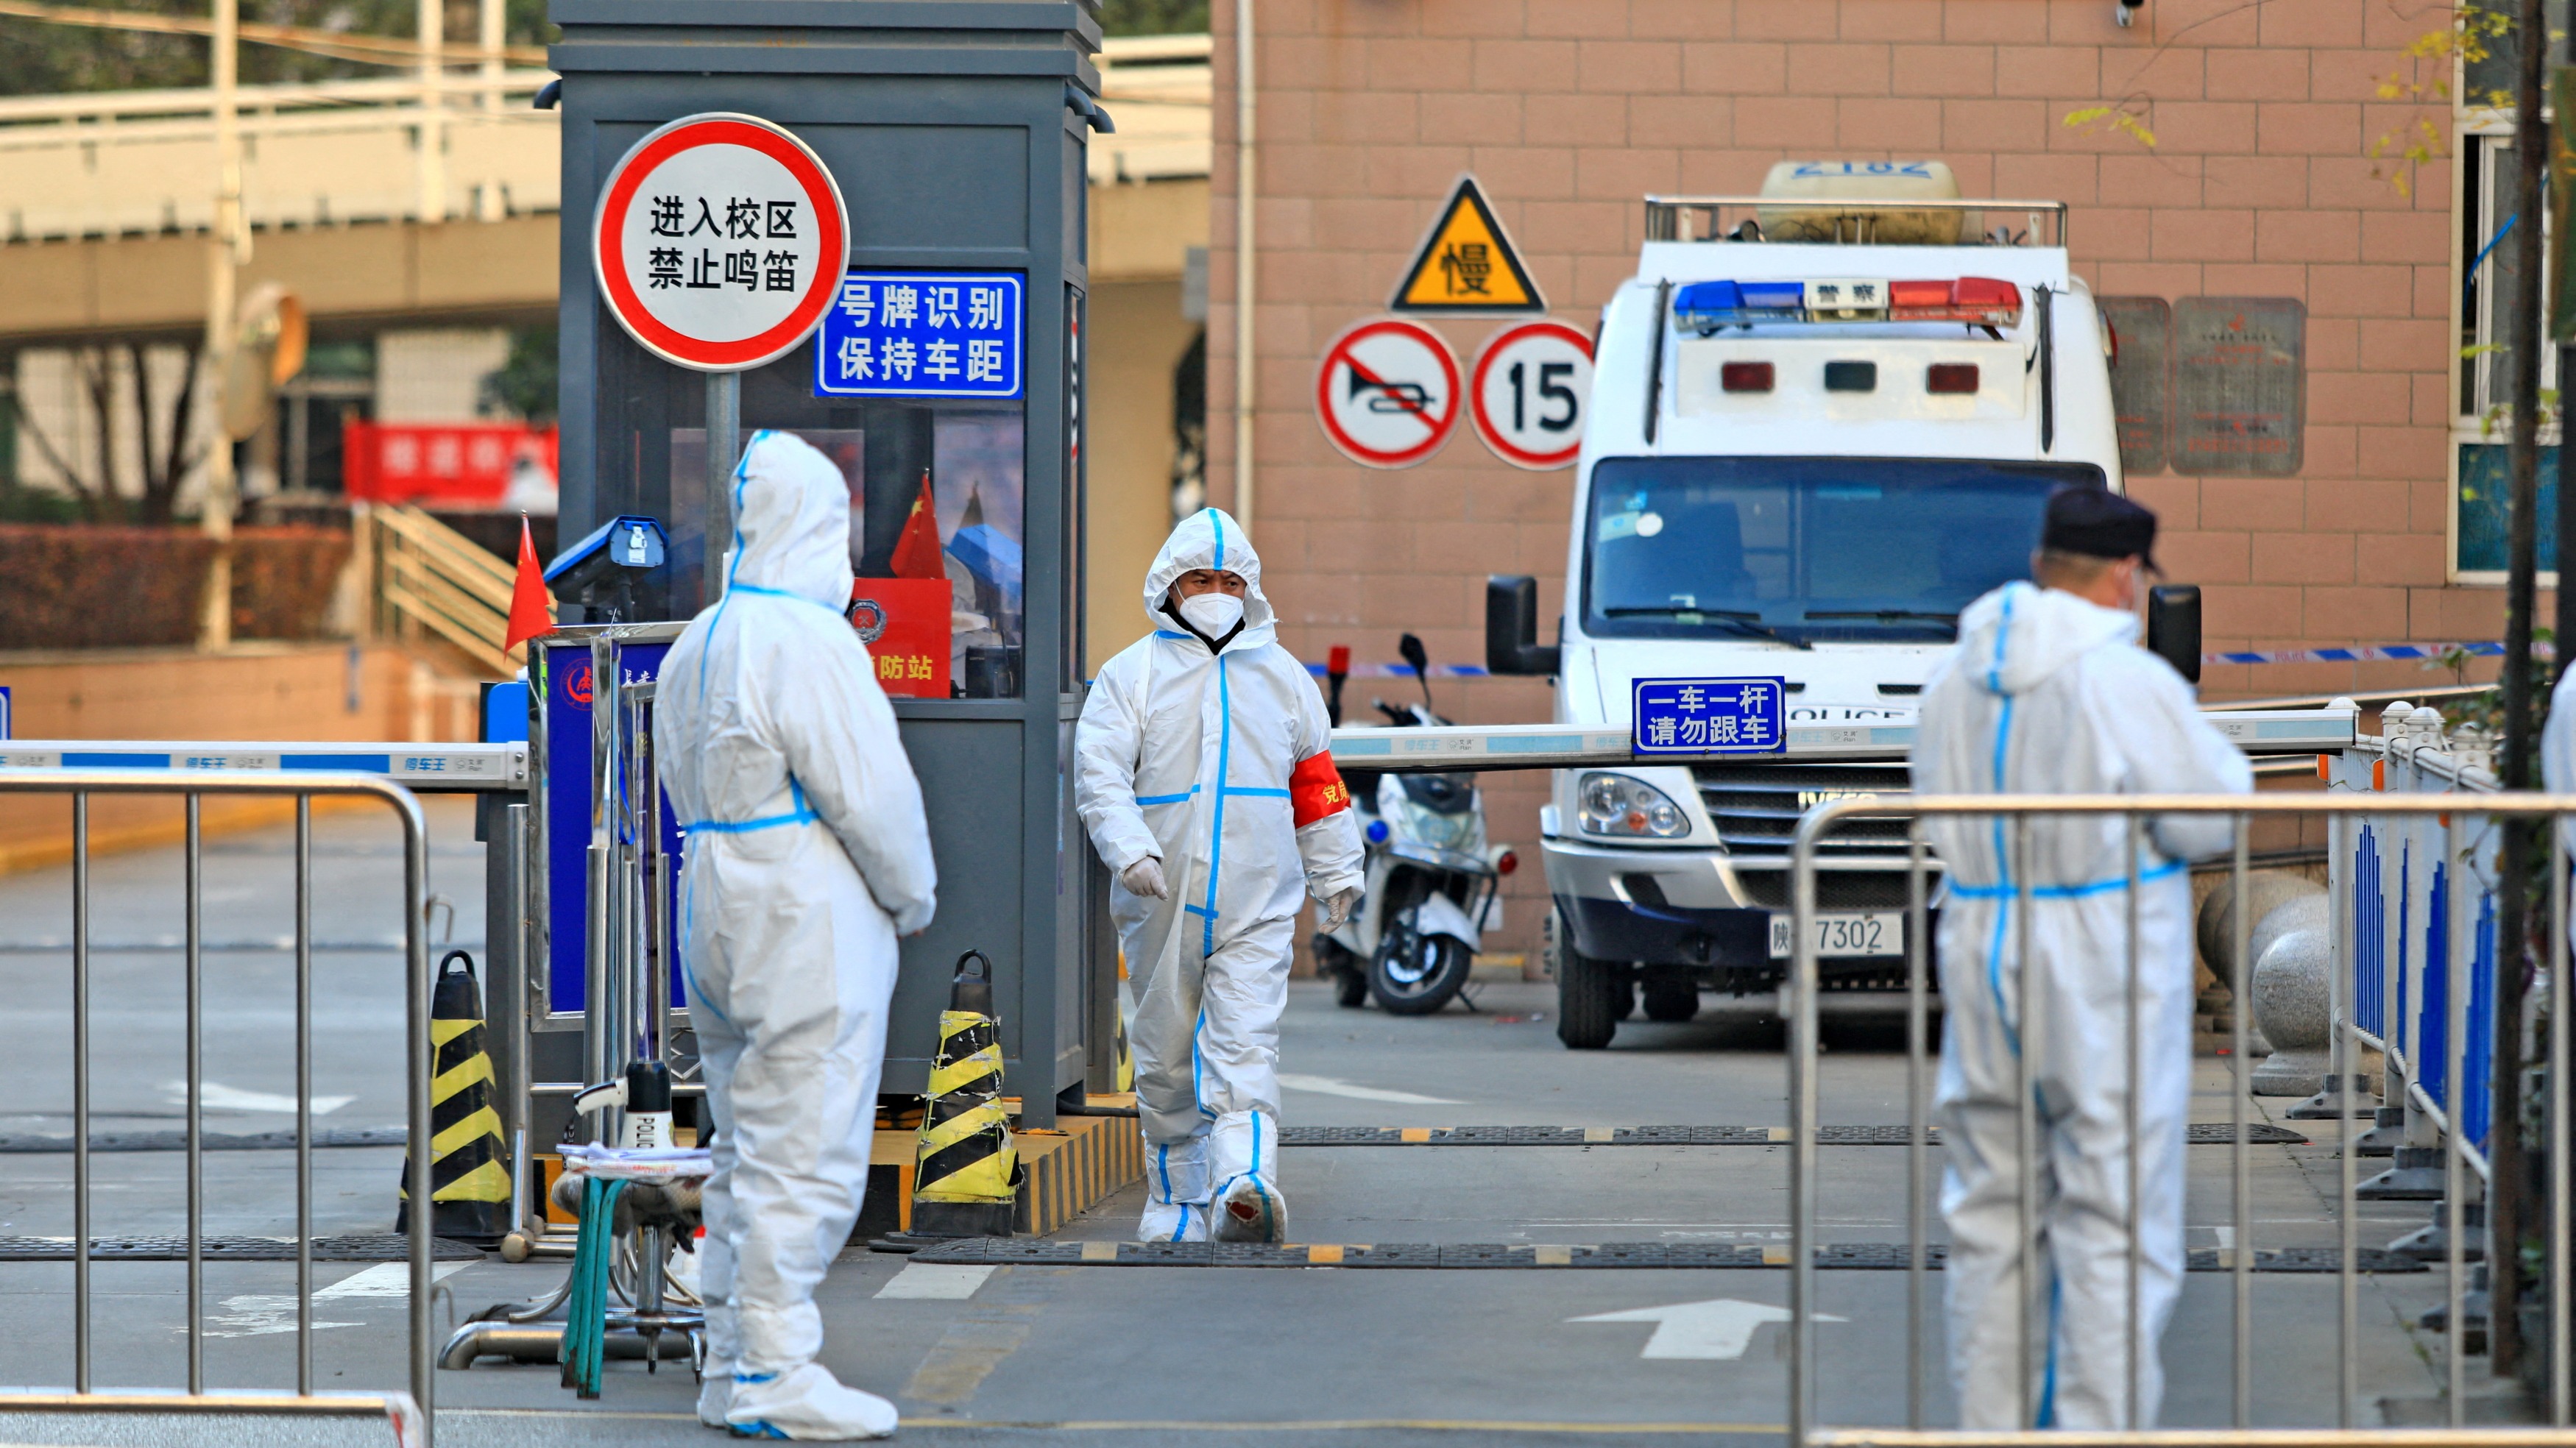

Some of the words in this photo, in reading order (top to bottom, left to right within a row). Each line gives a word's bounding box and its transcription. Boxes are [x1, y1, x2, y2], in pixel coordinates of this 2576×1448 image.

[651, 196, 796, 239] 进入校区
[648, 246, 799, 292] 禁止鸣笛
[1440, 243, 1491, 296] 慢
[839, 285, 1002, 330] 号牌识别
[1816, 284, 1875, 304] 警察
[838, 336, 1002, 383] 保持车距
[1509, 362, 1577, 433] 15
[621, 668, 660, 688] 长安
[871, 655, 933, 681] 防站
[1648, 686, 1769, 714] 一车一杆
[1404, 739, 1441, 751] 停车王
[1648, 716, 1770, 745] 请勿跟车
[405, 757, 447, 771] 停车王
[1323, 781, 1349, 805] 党员
[637, 1117, 655, 1148] POLIC
